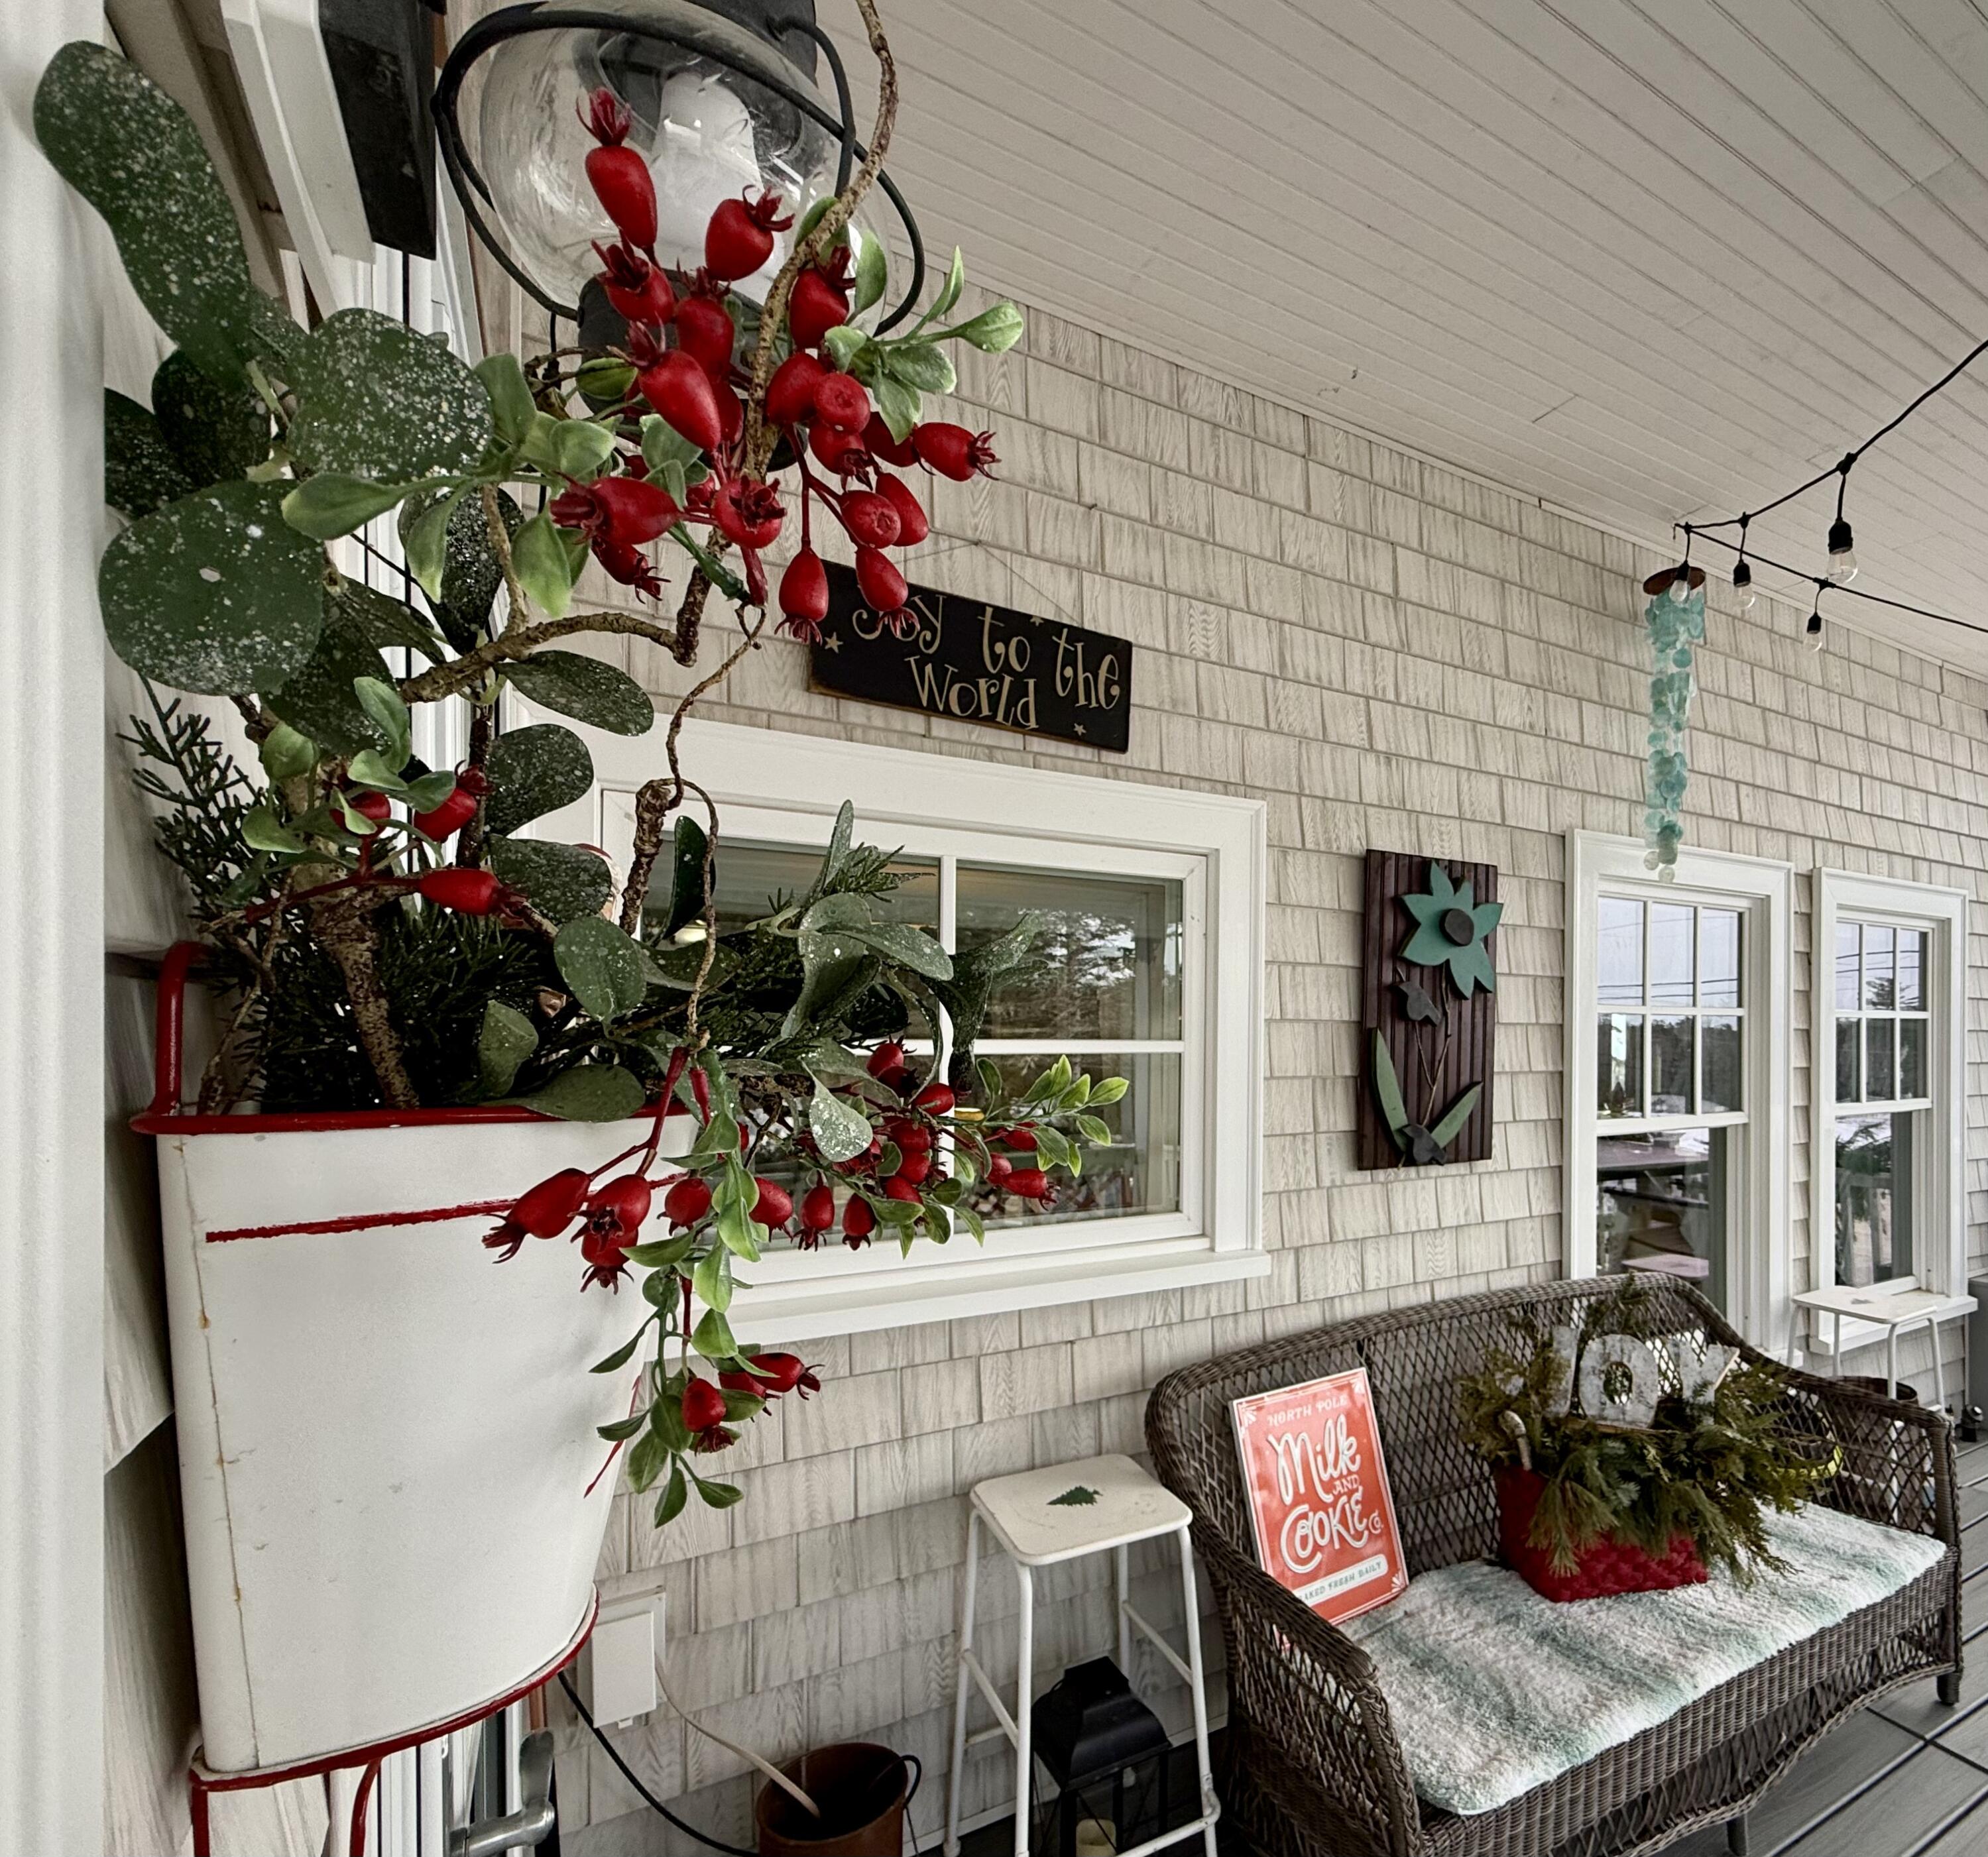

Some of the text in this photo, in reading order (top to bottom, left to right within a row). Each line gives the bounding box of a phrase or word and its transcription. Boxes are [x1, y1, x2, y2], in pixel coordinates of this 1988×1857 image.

[978, 606, 1030, 673] to
[1053, 628, 1120, 710] the
[1267, 1394, 1348, 1426] NORTH POLE
[1266, 1414, 1361, 1506] Milk
[1332, 1475, 1360, 1495] AND
[1280, 1485, 1369, 1574] COOKIE
[1328, 1573, 1355, 1589] FRESH
[1358, 1561, 1382, 1577] DAILY
